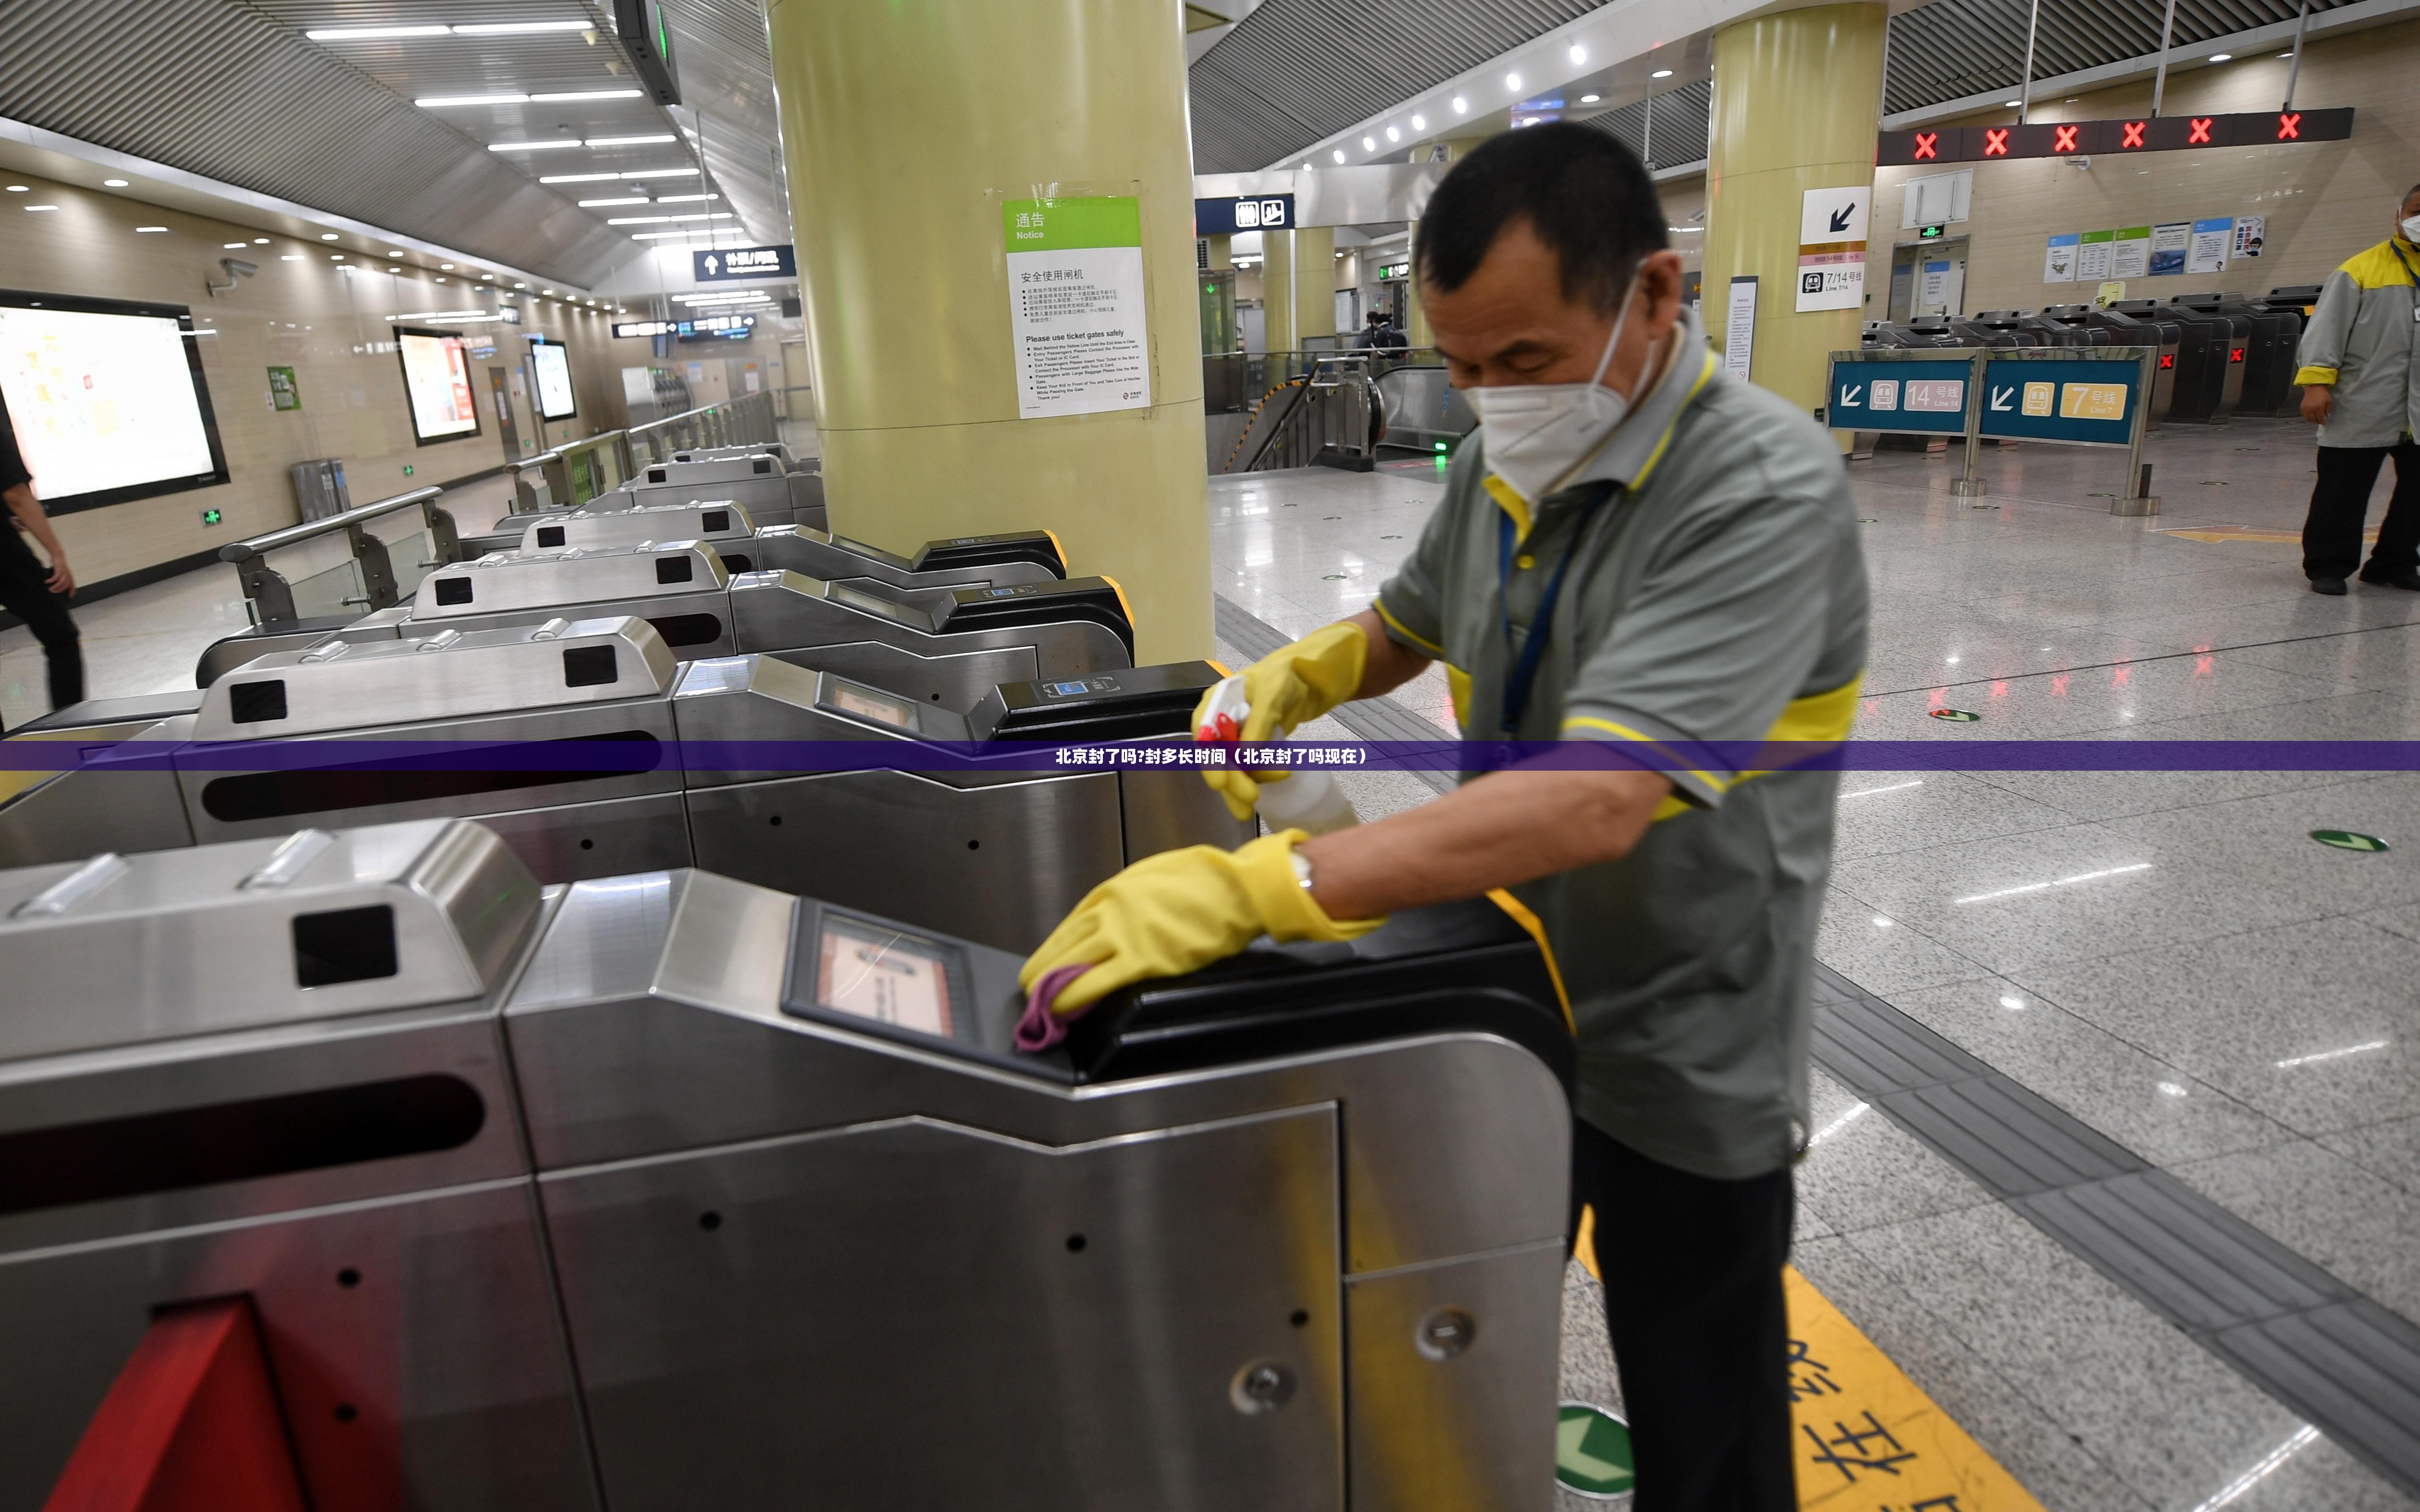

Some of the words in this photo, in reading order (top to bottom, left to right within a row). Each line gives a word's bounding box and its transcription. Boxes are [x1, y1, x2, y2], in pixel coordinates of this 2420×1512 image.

[1016, 212, 1045, 228] 通告
[1016, 231, 1044, 239] Notice
[1021, 269, 1084, 283] 安全使用闸机
[1087, 332, 1104, 340] gates
[1909, 385, 1929, 406] 14
[1936, 386, 1958, 398] 号线
[2073, 387, 2089, 415] 7
[2091, 391, 2116, 404] 号线
